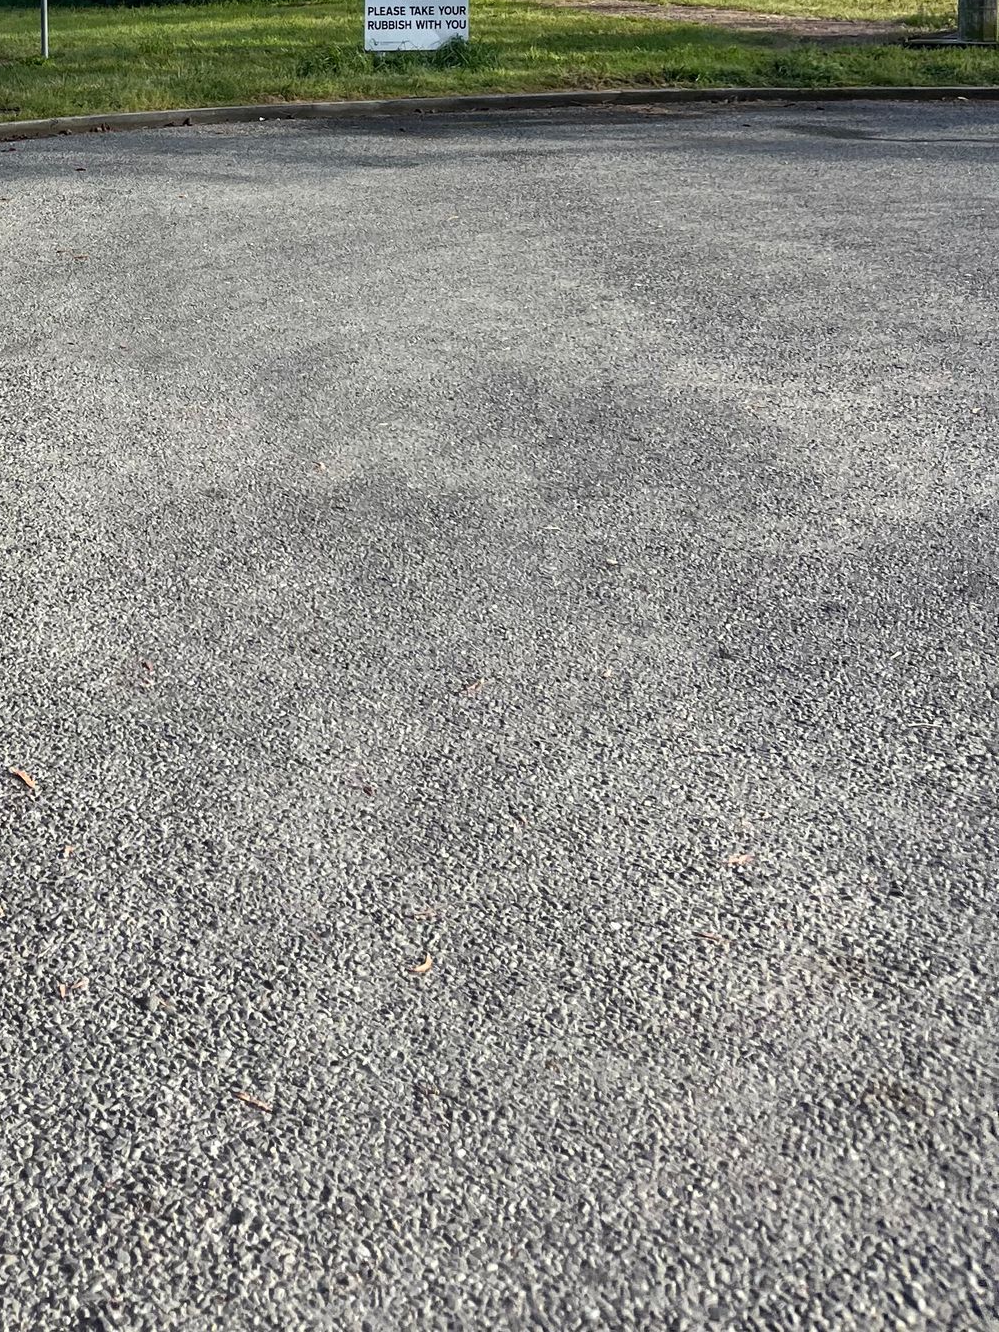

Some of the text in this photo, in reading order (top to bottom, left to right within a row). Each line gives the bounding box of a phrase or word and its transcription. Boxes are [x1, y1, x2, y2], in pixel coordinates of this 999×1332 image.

[367, 6, 466, 16] PLEASE TAKE YOUR
[367, 19, 467, 30] RUBBISH WITH YOU
